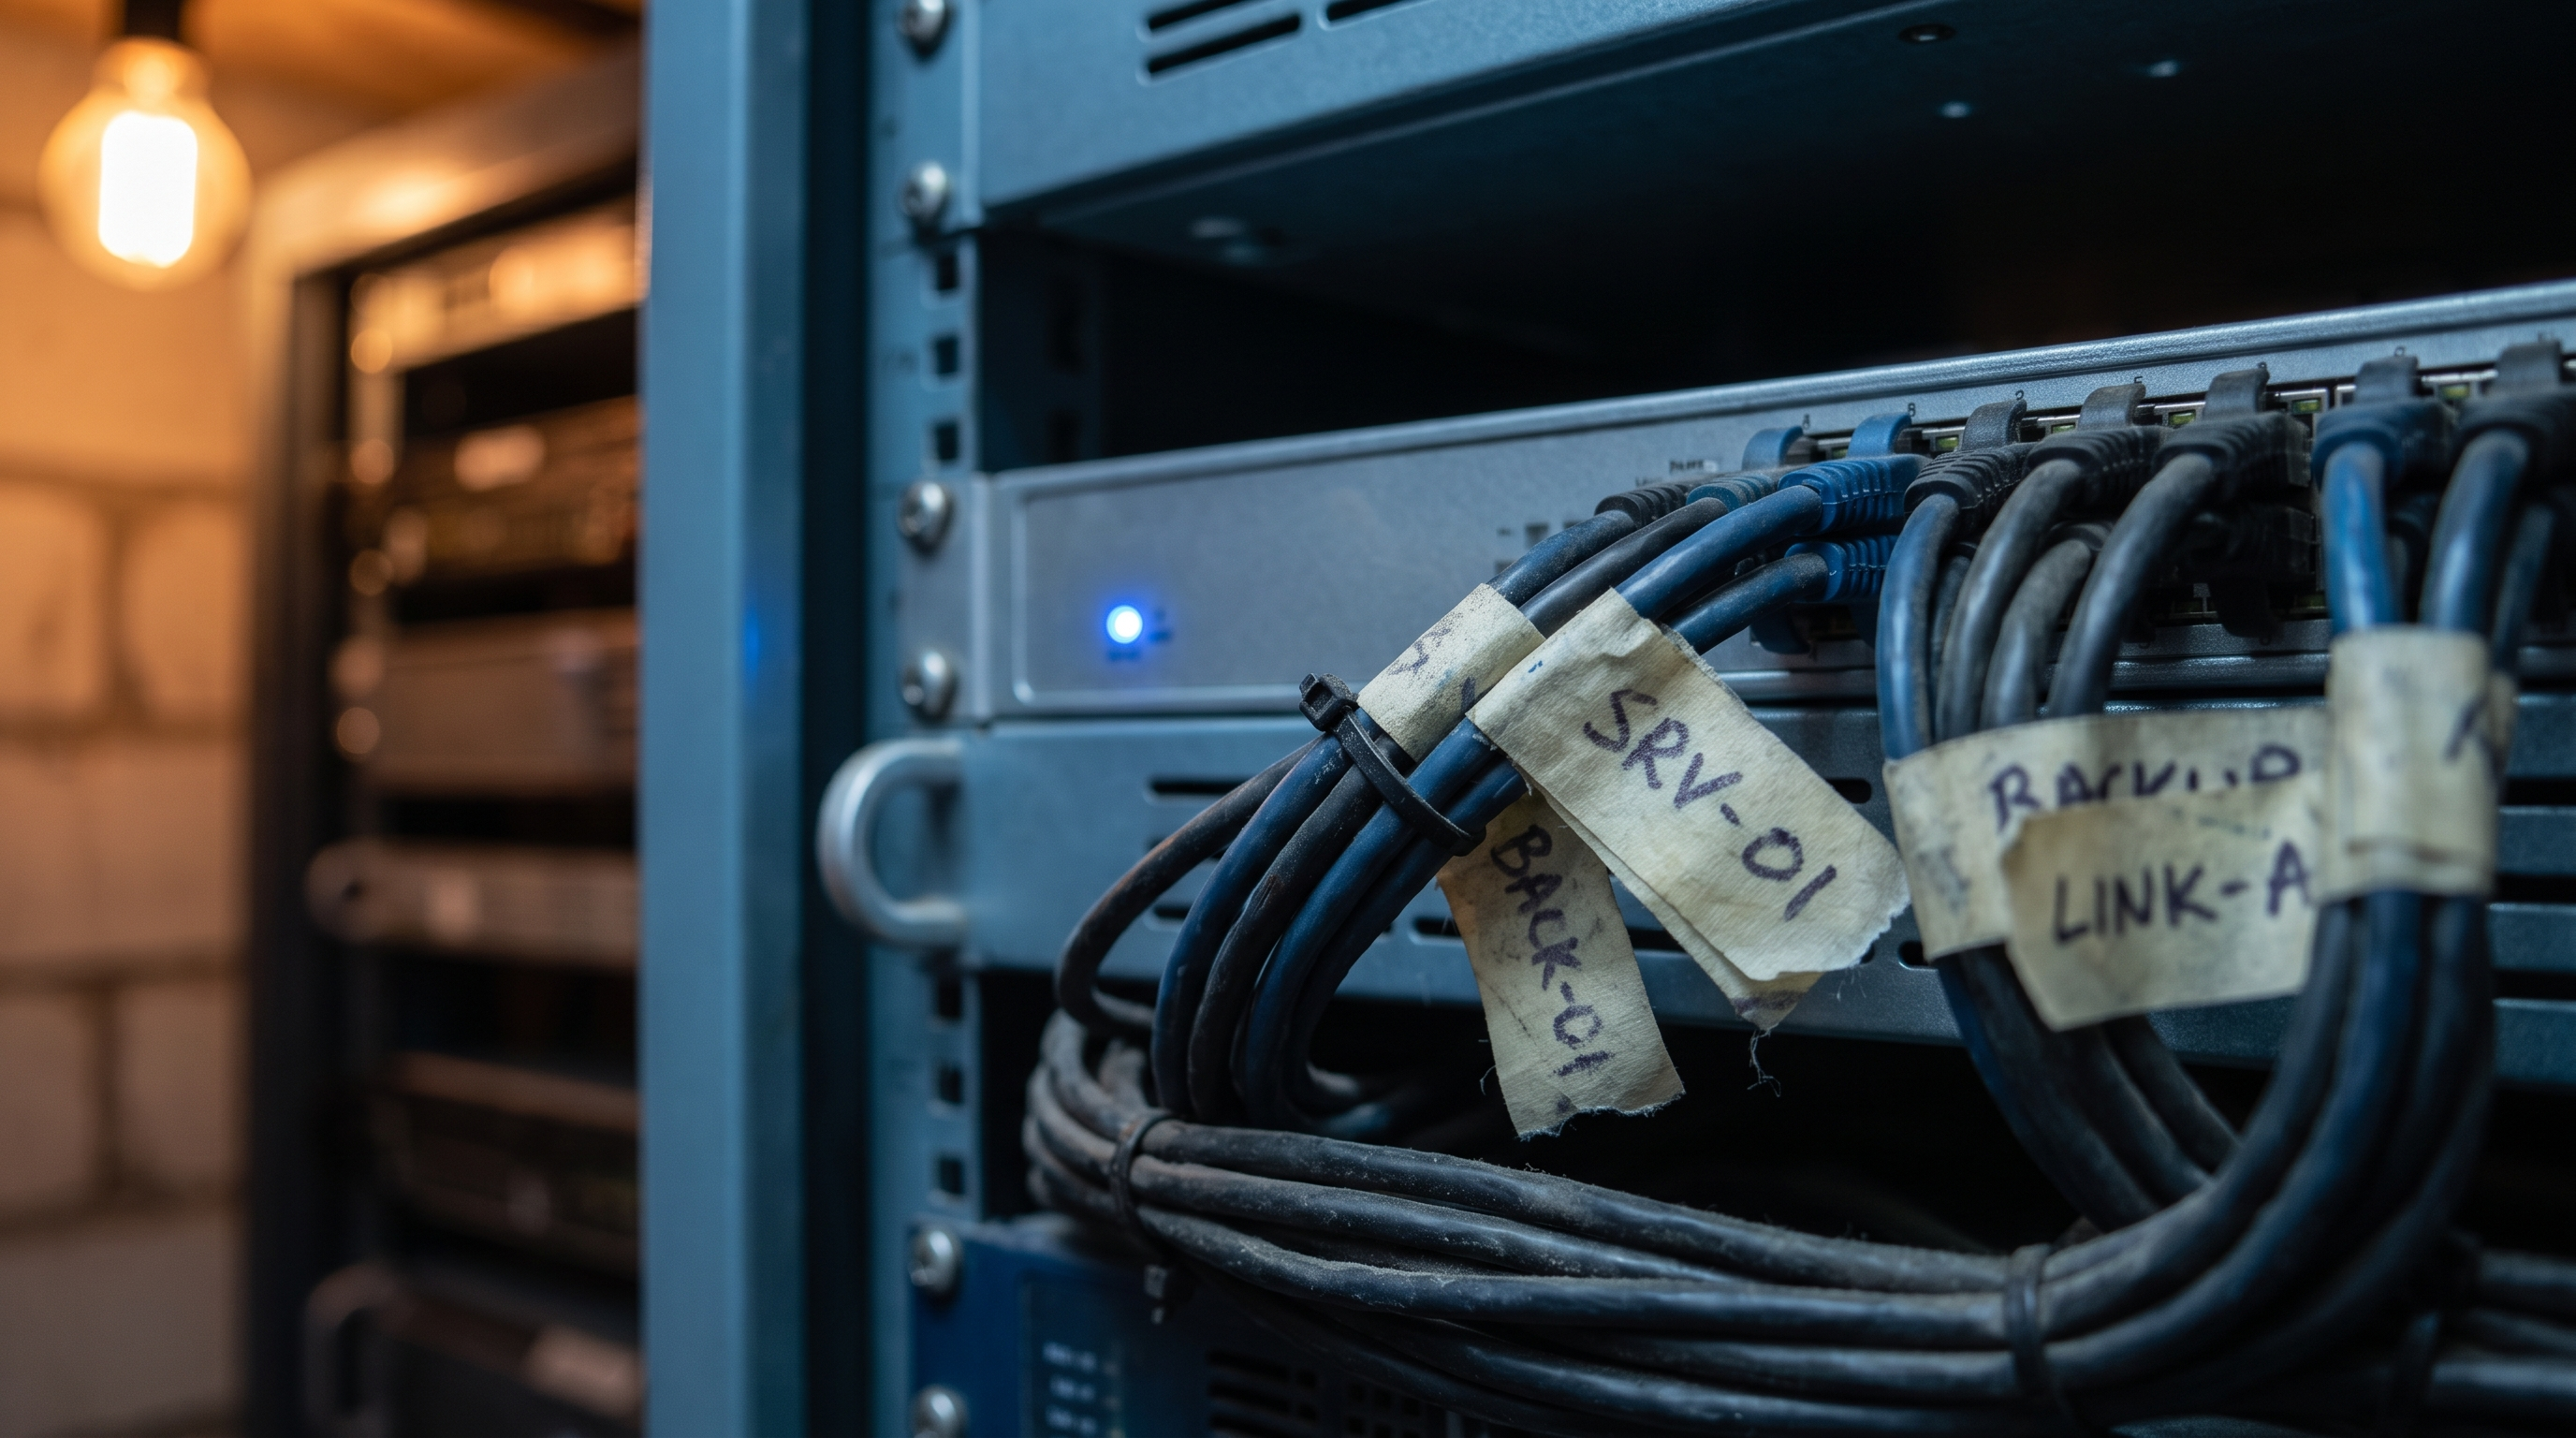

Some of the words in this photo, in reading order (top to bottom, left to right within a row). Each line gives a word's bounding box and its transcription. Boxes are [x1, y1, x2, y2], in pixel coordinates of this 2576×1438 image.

[1583, 688, 1837, 922] SRV-01
[2055, 838, 2314, 947] LINK-A
[1490, 823, 1616, 1078] BACK-01
